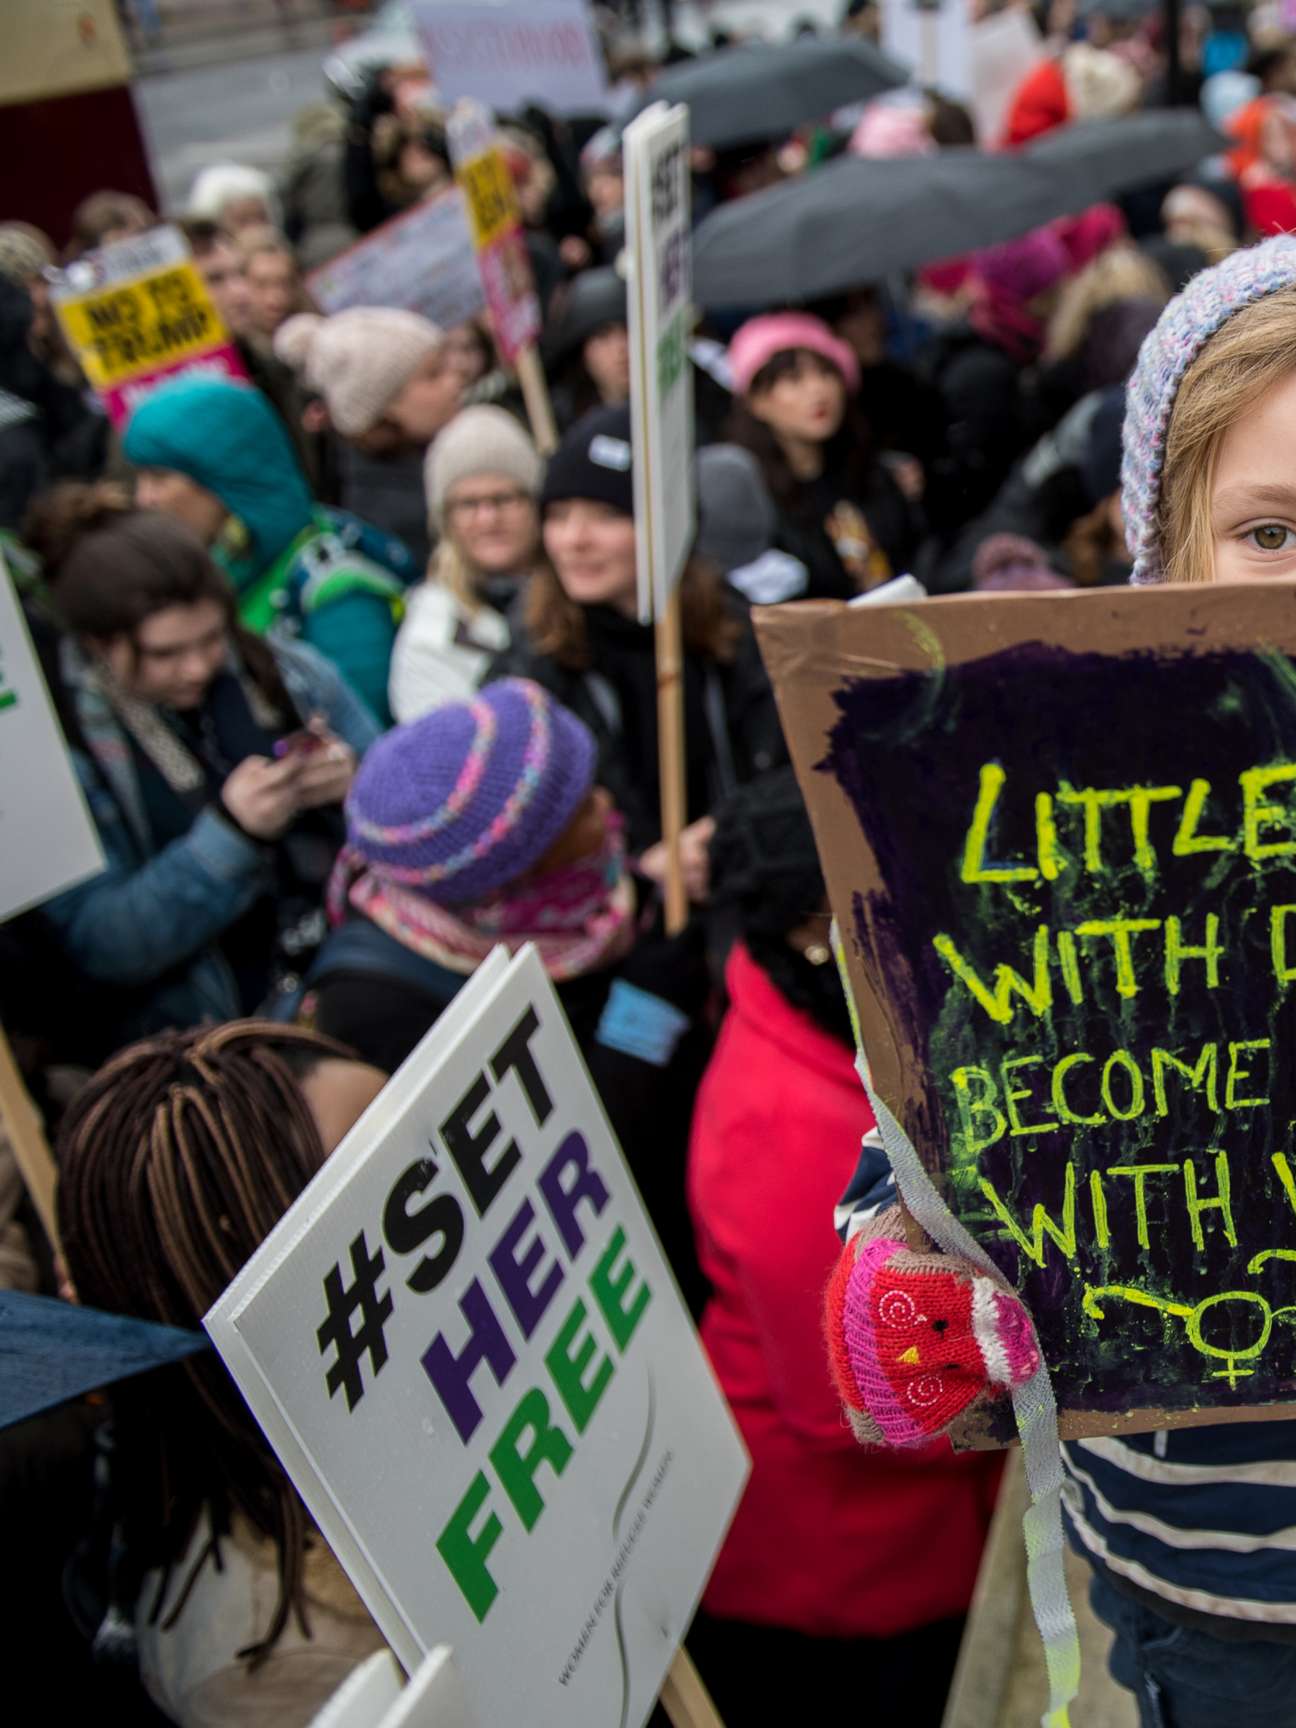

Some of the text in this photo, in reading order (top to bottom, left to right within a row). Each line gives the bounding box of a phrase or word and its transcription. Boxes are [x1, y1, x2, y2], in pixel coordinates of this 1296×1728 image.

[933, 914, 1221, 1022] WITH
[951, 1039, 1271, 1153] BECOME
[316, 1002, 555, 1413] #SET
[419, 1128, 611, 1447] HER
[981, 1149, 1239, 1266] WITH
[435, 1224, 653, 1625] FREE
